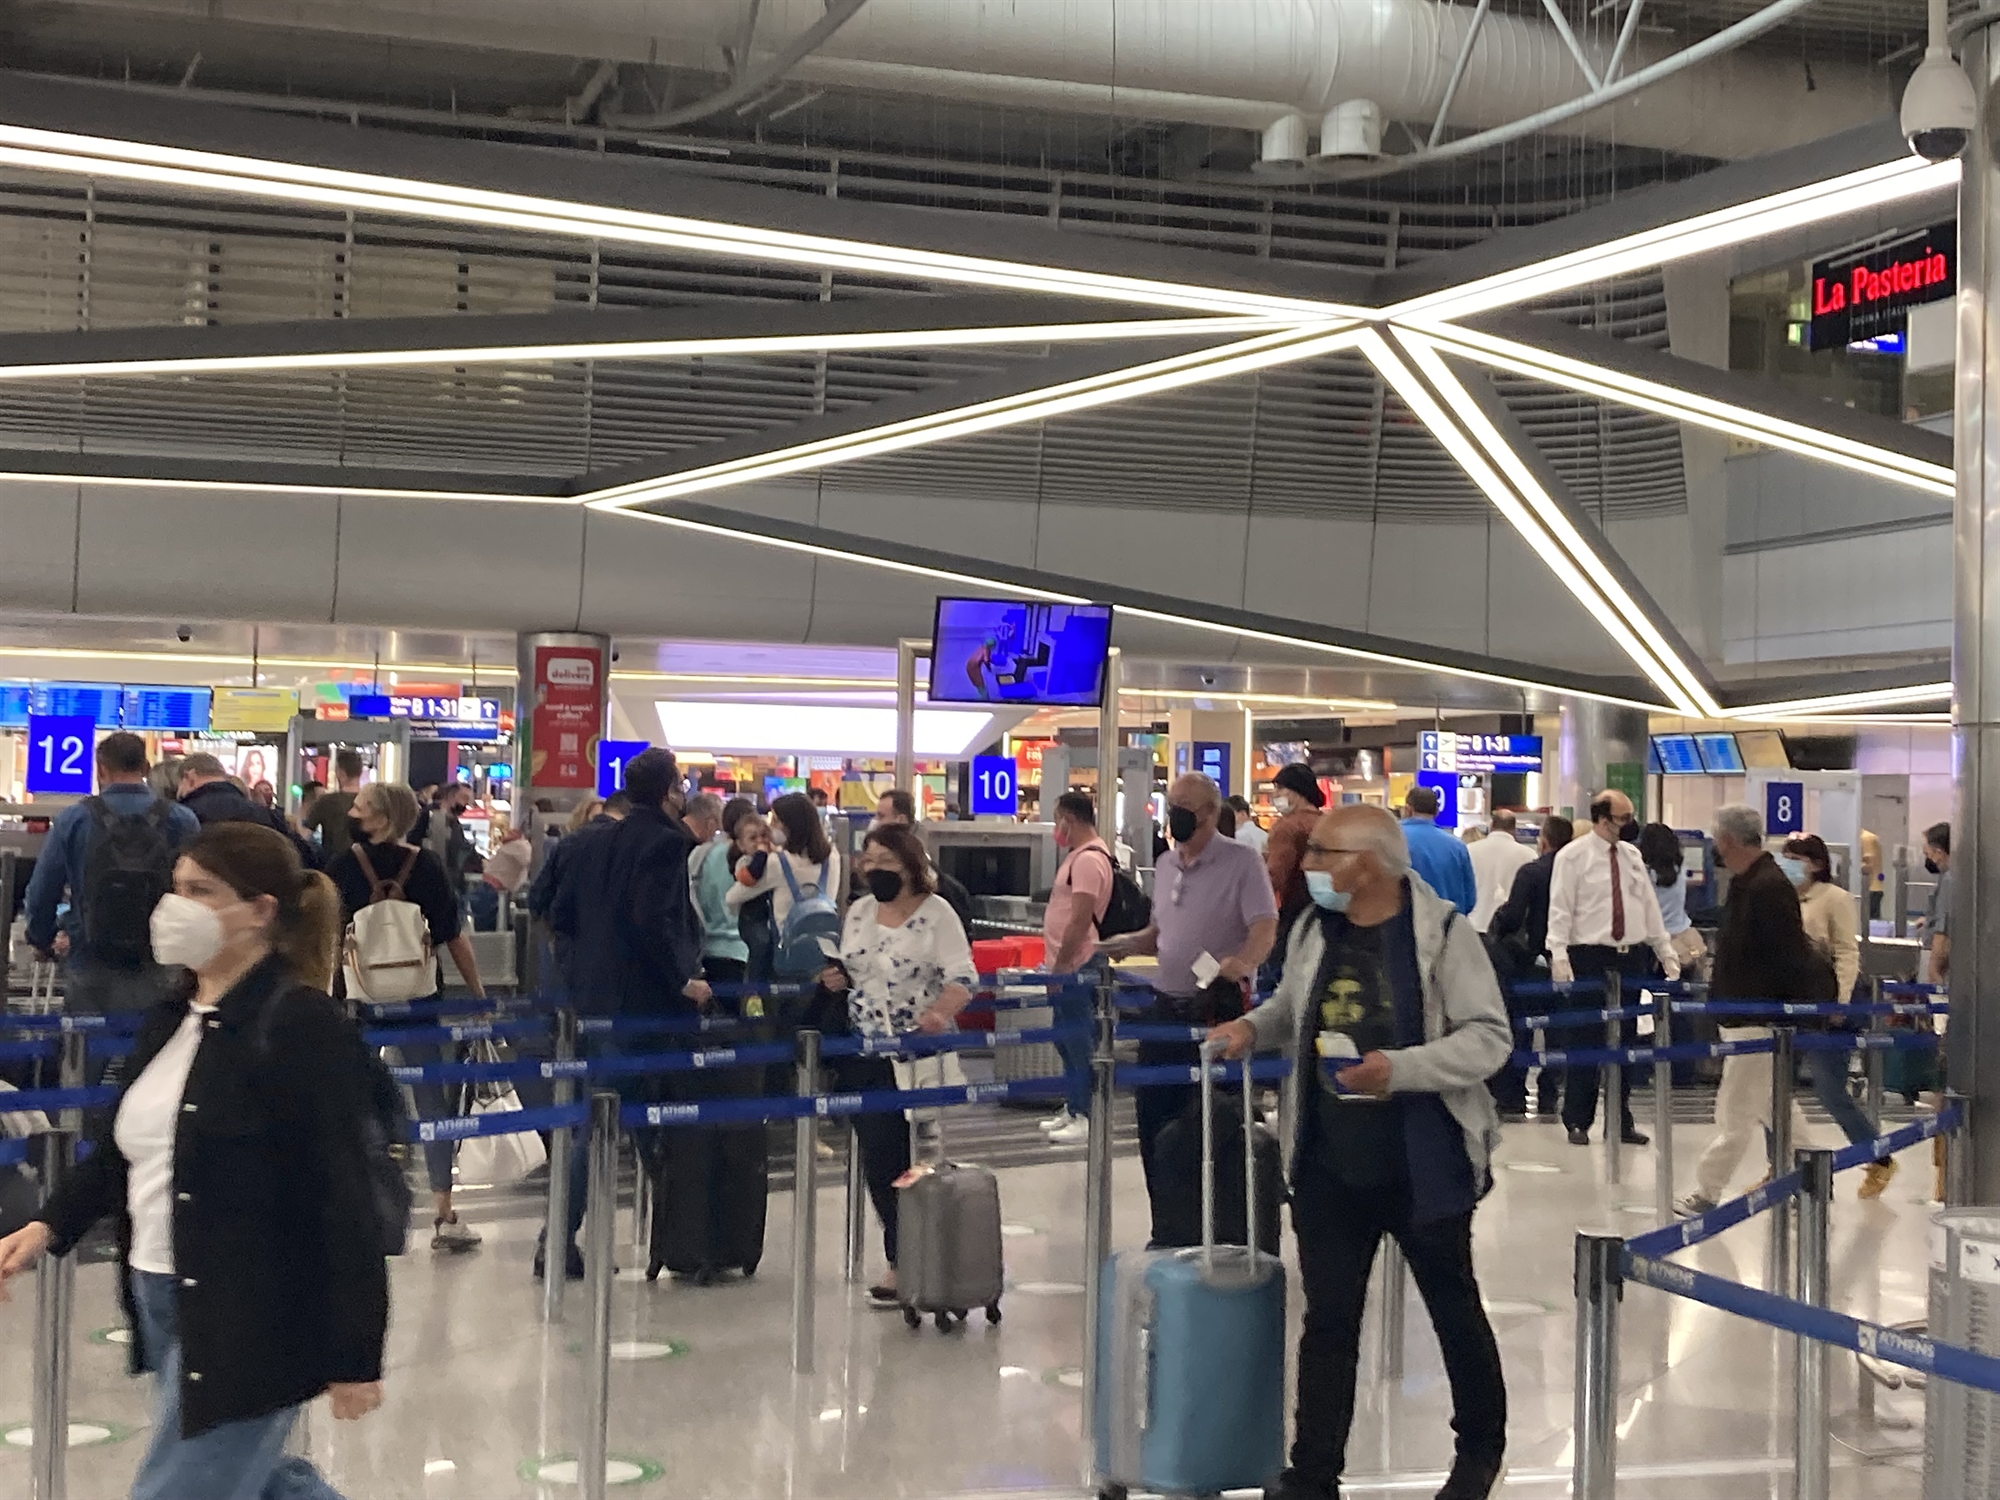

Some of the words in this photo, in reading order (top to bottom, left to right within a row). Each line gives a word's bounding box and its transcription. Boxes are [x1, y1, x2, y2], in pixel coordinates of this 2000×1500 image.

[1815, 277, 1846, 315] La
[1851, 246, 1947, 304] Pasteria
[552, 668, 590, 682] delivery
[412, 698, 424, 716] B
[427, 698, 458, 717] 1-31
[37, 734, 84, 775] 12
[1472, 735, 1482, 751] B
[1485, 735, 1510, 752] 1-31
[978, 770, 1011, 800] 10
[1777, 795, 1792, 823] 8
[662, 1105, 699, 1115] ATHENS
[436, 1117, 480, 1132] ATHENS
[1879, 1330, 1936, 1358] ATHENS
